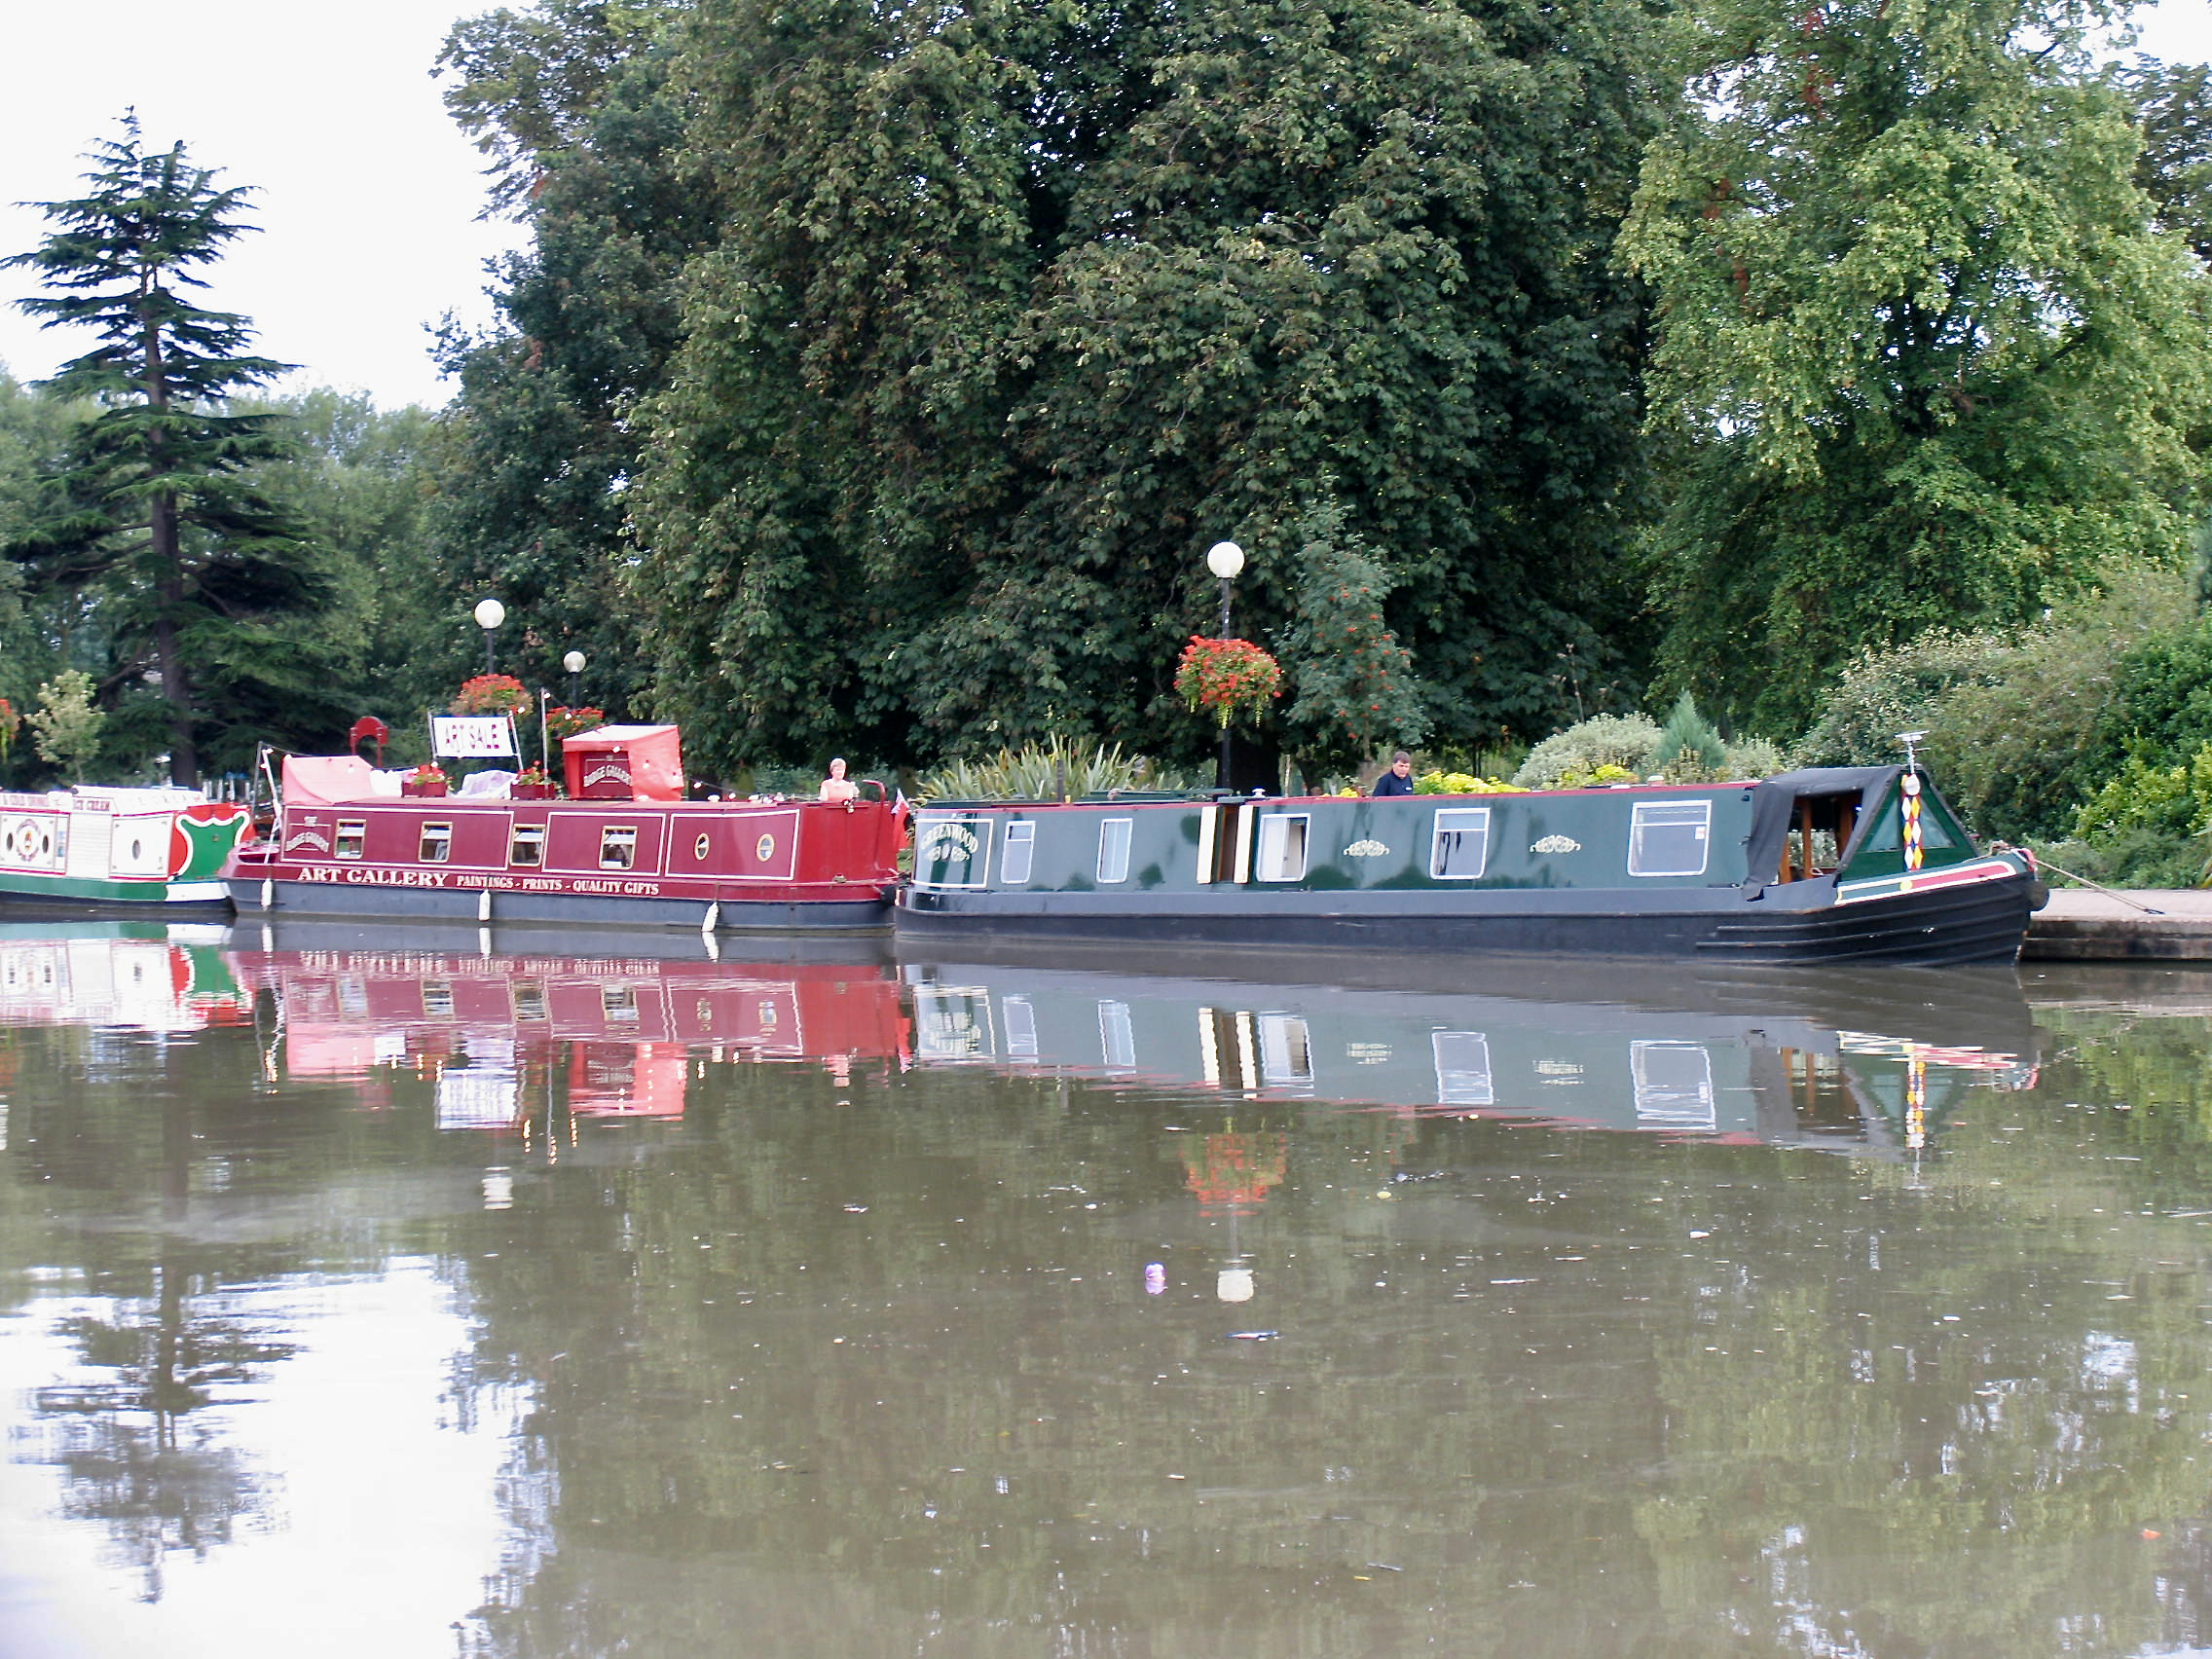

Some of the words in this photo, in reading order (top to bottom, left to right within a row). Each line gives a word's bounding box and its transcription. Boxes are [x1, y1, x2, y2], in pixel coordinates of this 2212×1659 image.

[920, 823, 978, 854] GREENWOOD
[298, 867, 342, 882] ART
[347, 868, 448, 887] GALLERY
[457, 875, 514, 889] PAINTINGS
[522, 878, 563, 891] PRINTS
[572, 880, 622, 894] QUALITY
[624, 882, 659, 896] GIFTS
